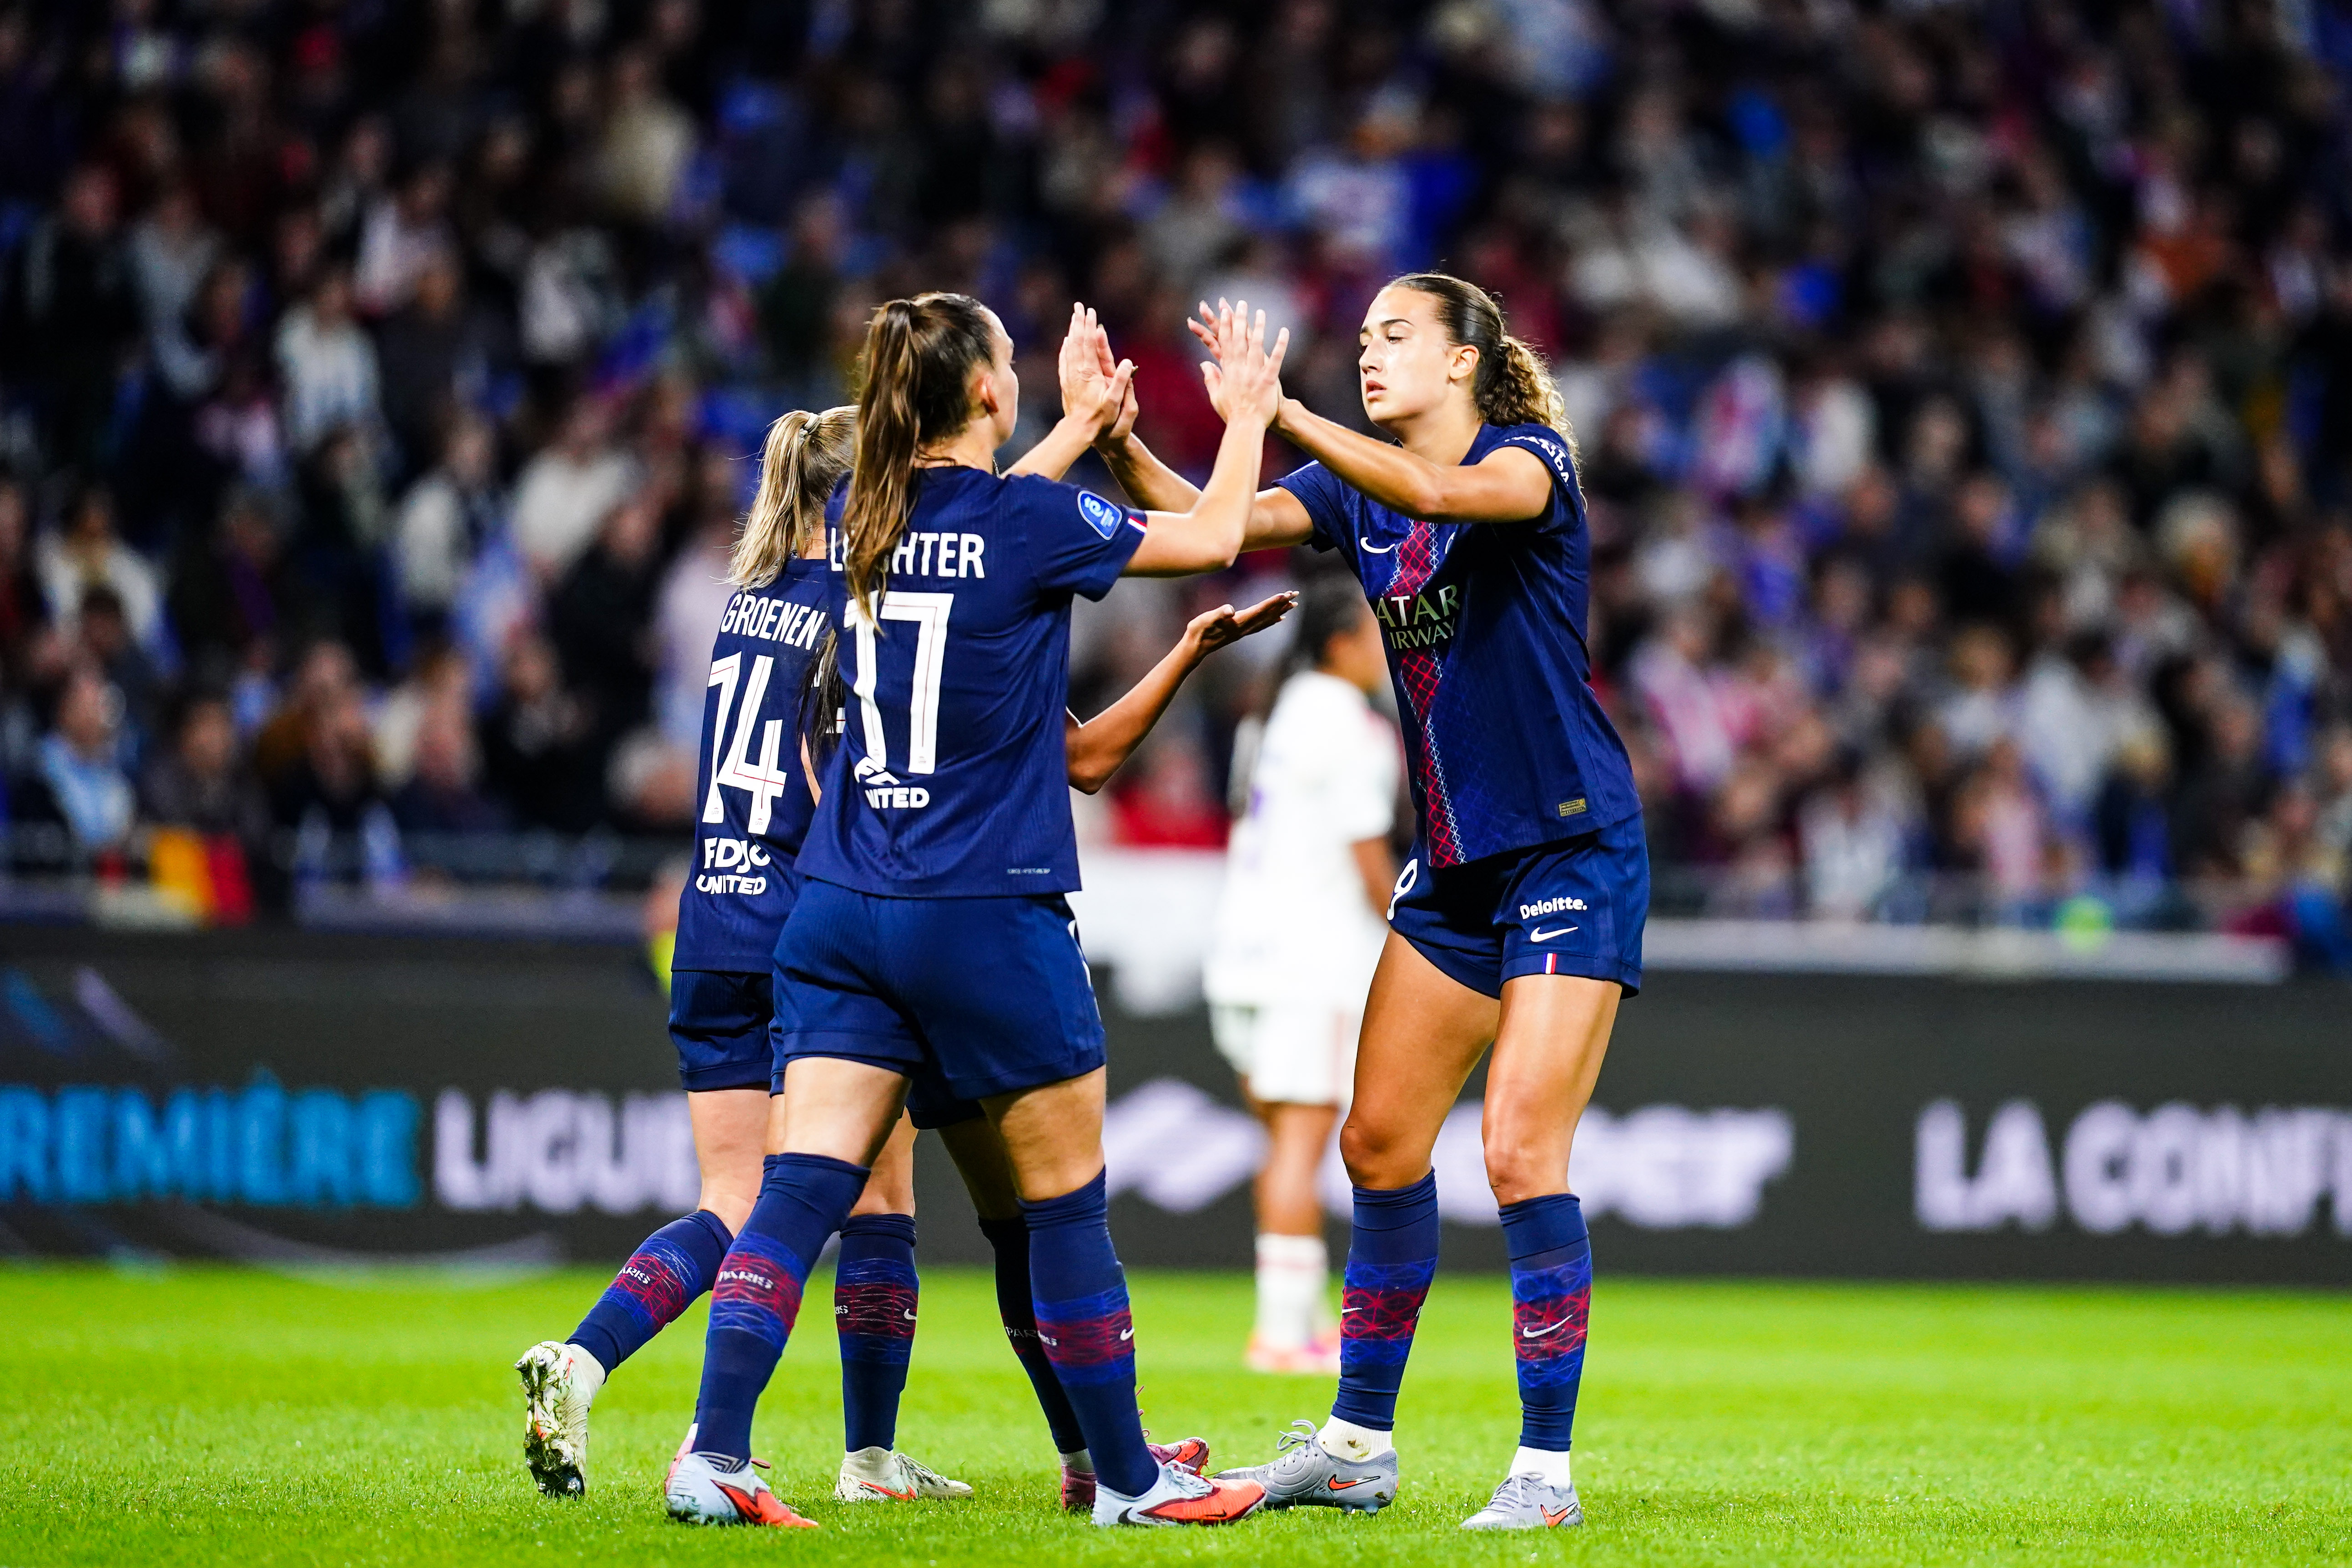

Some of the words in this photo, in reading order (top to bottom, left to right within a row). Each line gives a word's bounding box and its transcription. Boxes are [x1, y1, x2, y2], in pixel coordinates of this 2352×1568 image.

[830, 528, 985, 578] LHTER
[720, 593, 826, 650] GROENEN
[1377, 585, 1460, 627] ATAR
[1390, 617, 1455, 649] IRWAY
[844, 590, 955, 774] 17
[702, 651, 786, 835] 14
[696, 874, 767, 895] UNITED
[1387, 858, 1418, 920] 9
[1520, 897, 1588, 920] Deloitte.
[0, 1064, 424, 1207] REMIÈRE
[1914, 1096, 2057, 1235] LA
[617, 1266, 651, 1284] ARIS
[1005, 1326, 1036, 1338] PAR
